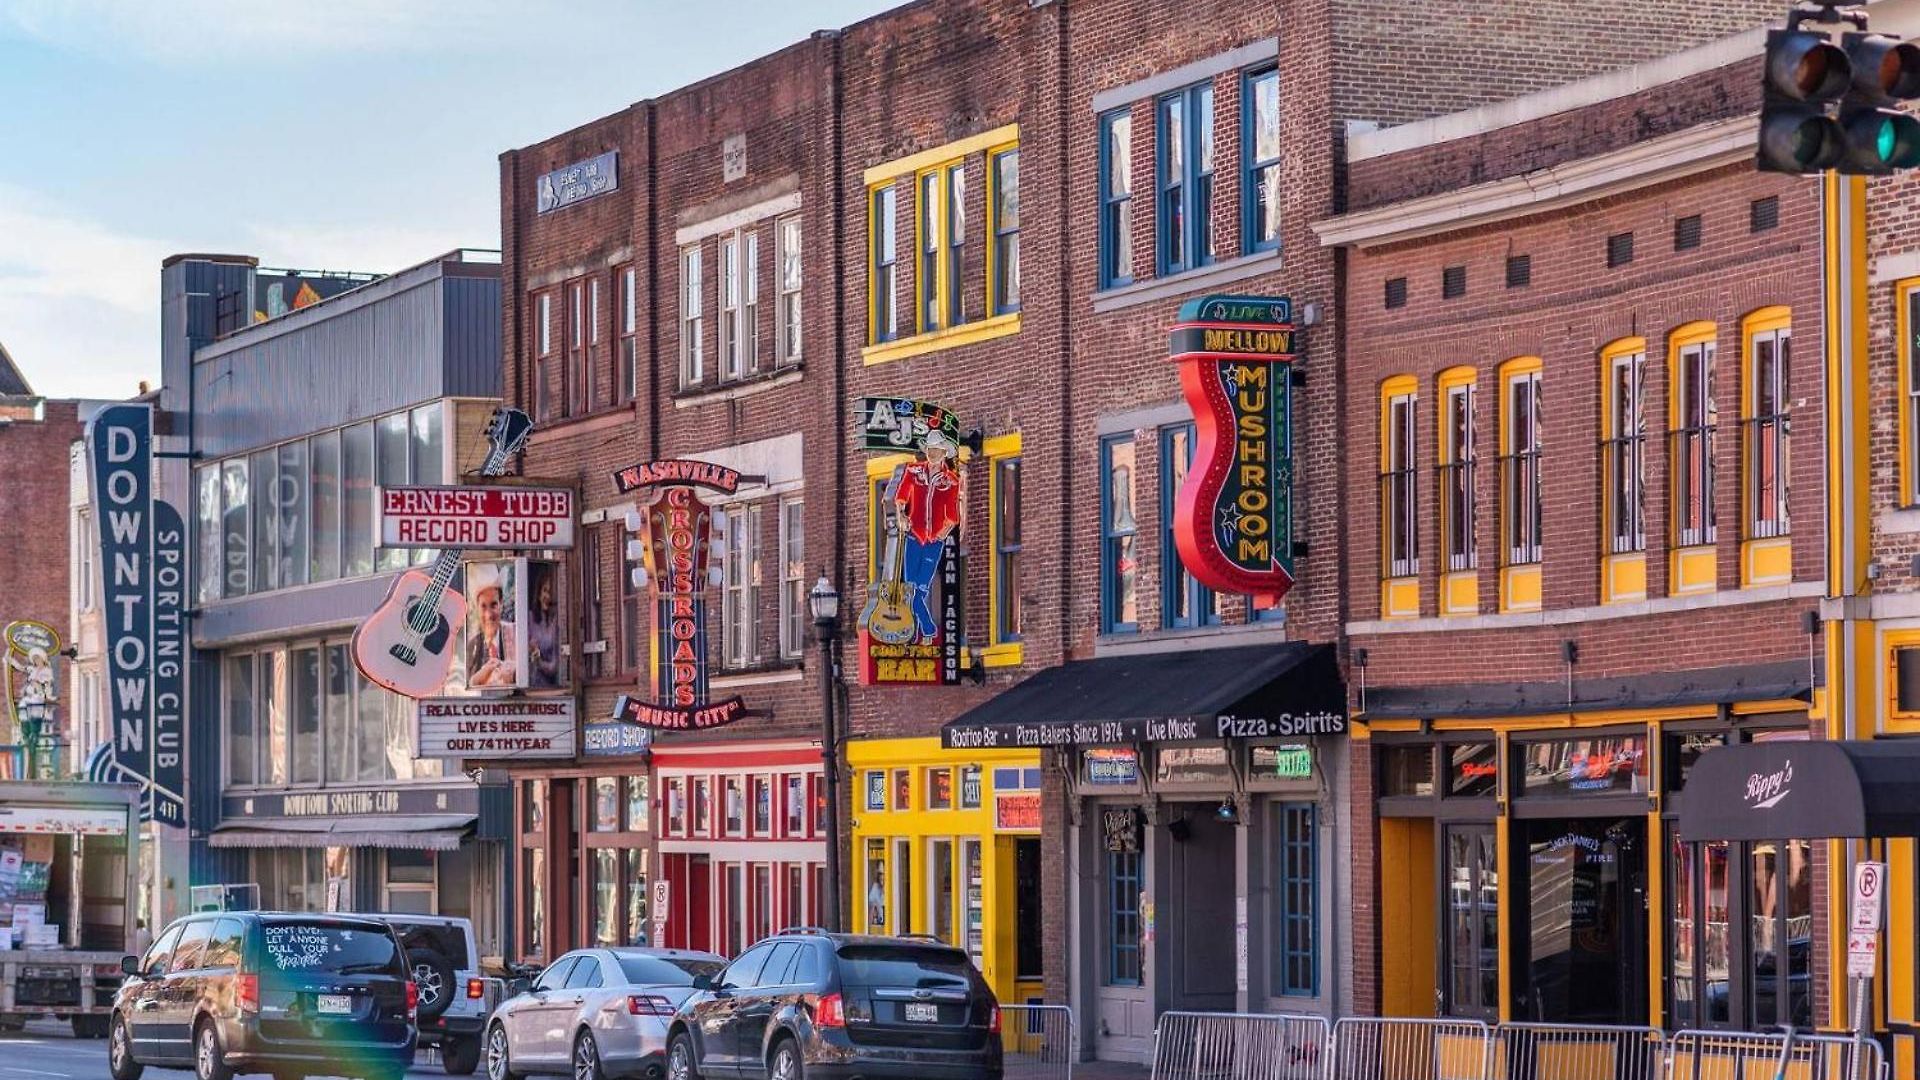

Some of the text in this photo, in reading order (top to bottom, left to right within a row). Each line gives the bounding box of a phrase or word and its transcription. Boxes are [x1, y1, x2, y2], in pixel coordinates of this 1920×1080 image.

[1230, 306, 1265, 319] LIVE
[1204, 328, 1290, 353] MELLOW
[622, 461, 739, 491] NASHVILLE
[1237, 365, 1269, 562] MUSHROOM
[385, 489, 568, 516] ERNEST TUBB
[399, 518, 557, 543] RECORD SHOP
[107, 425, 146, 753] DOWNTOWN
[668, 488, 698, 707] CROSSROADS
[944, 534, 957, 682] ALAN JACKSON
[157, 530, 180, 769] SPORTING CLUB
[876, 658, 937, 682] BAR
[426, 703, 567, 717] REAL COUNTRY MUSIC
[458, 721, 535, 734] LIVES HERE
[951, 726, 998, 748] Rooftop Bar
[1016, 721, 1123, 745] Pizza Bakers Since 1974
[1146, 716, 1197, 741] Live Music
[1217, 711, 1344, 738] Pizza Spirits
[446, 739, 475, 751] OUR
[512, 737, 551, 750] YEAR
[585, 726, 647, 750] RECORD SHOP
[1743, 759, 1793, 802] Rippy's
[159, 802, 178, 821] 411
[284, 791, 400, 816] DOWNTOWN SPORTING CLUB
[1586, 854, 1614, 863] FIRE
[266, 935, 329, 945] LET ANYONE
[267, 944, 329, 954] DULL YOUR
